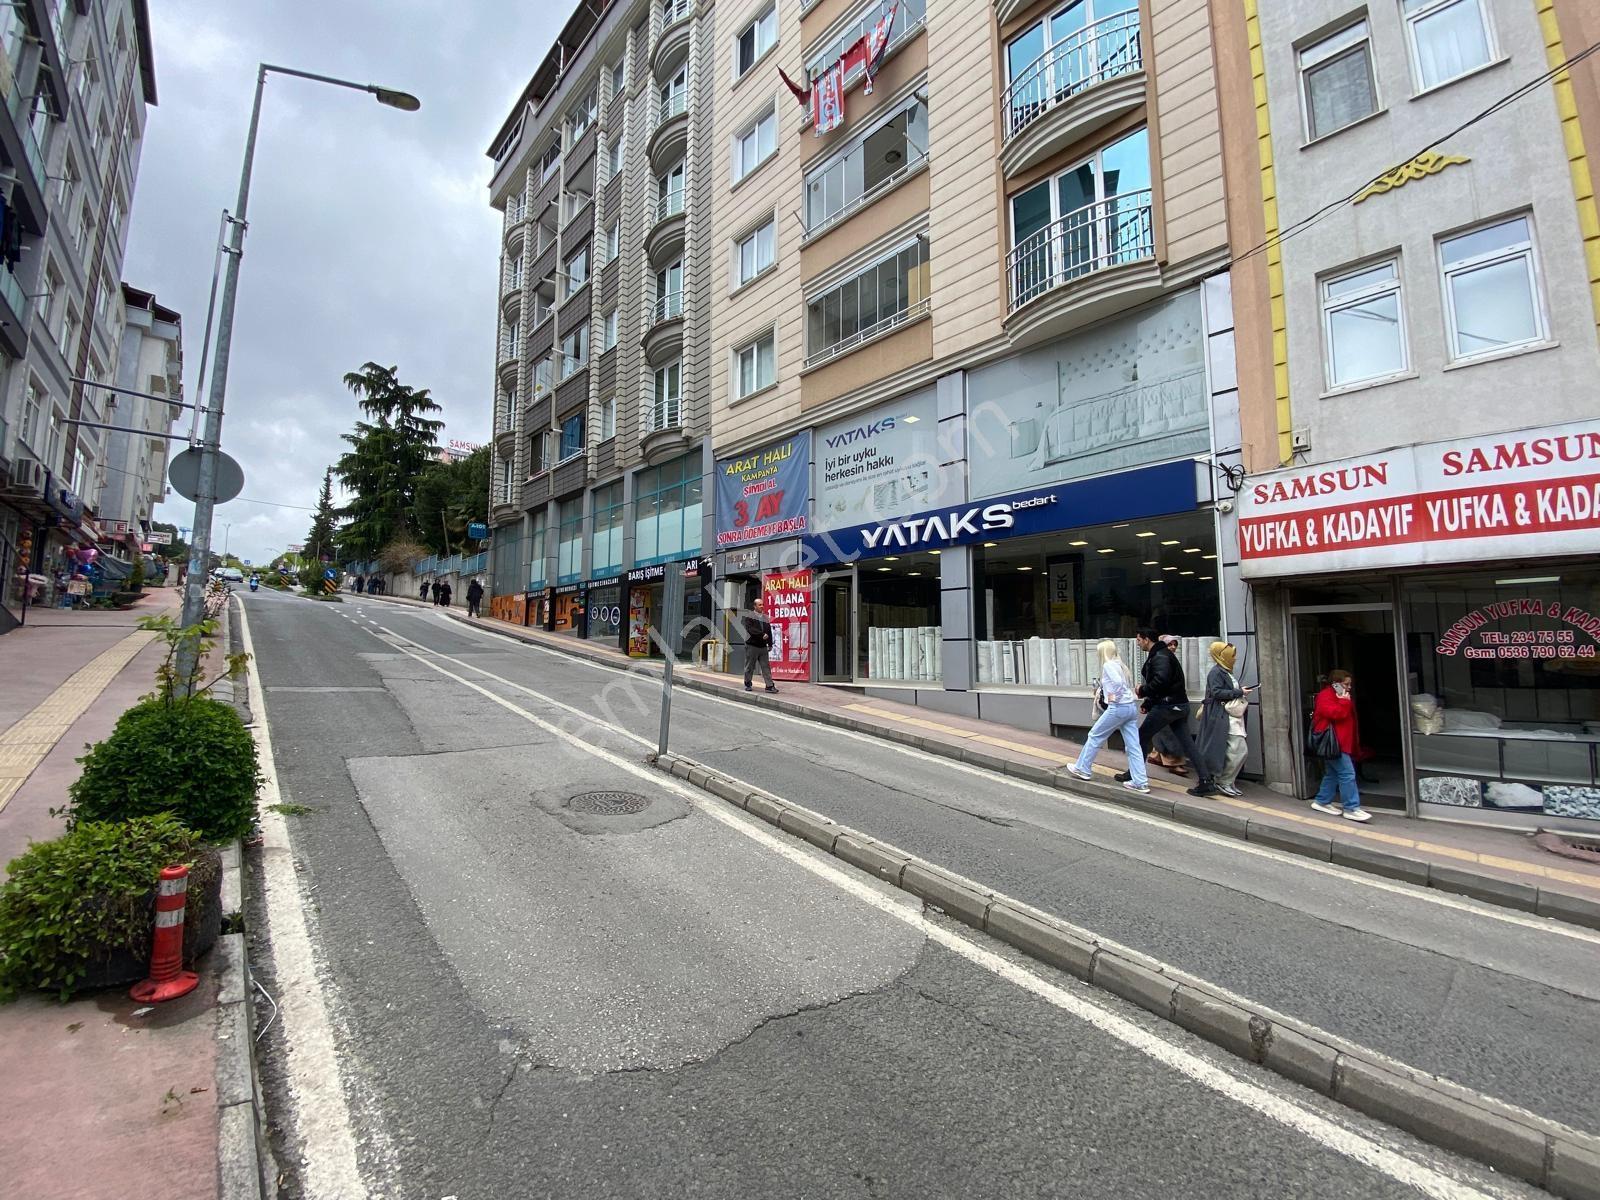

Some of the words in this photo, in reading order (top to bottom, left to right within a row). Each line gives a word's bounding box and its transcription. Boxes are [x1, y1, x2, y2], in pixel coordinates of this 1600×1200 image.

[826, 417, 895, 448] YATAKS
[726, 455, 760, 476] ARAT
[763, 443, 792, 466] HALI
[825, 458, 836, 471] İyi
[838, 454, 850, 466] bir
[853, 447, 877, 462] uyku
[825, 464, 864, 482] herkesin
[866, 455, 894, 471] hakkı
[741, 466, 779, 483] KAMPANYA
[767, 478, 777, 489] AL
[1253, 461, 1389, 505] SAMSUN
[733, 500, 749, 527] 3
[754, 490, 785, 523] AY
[860, 503, 1015, 549] YATAKS
[1012, 494, 1057, 510] bedart
[1426, 495, 1509, 533] YUFKA
[1515, 491, 1533, 526] &
[718, 529, 743, 544] SONRA
[743, 524, 777, 541] ÖDEMEYE
[777, 515, 806, 533] BAŞLA
[1241, 520, 1302, 553] YUFKA
[1305, 517, 1319, 546] &
[1322, 502, 1414, 544] KADAYIF
[765, 579, 785, 592] ARAT
[788, 575, 809, 588] HALI
[774, 592, 805, 605] ALANA
[774, 606, 808, 618] BEDAVA
[1436, 610, 1488, 656] SAMSUN
[1483, 599, 1543, 620] YUFKA
[1547, 601, 1561, 618] &
[1481, 632, 1509, 644] TEL:
[1511, 631, 1535, 643] 234
[1537, 631, 1555, 643] 75
[1556, 630, 1574, 643] 55
[1464, 647, 1496, 659] Gsm:
[1498, 646, 1529, 658] 0536
[1531, 645, 1556, 658] 790
[1557, 645, 1576, 658] 62
[1577, 644, 1596, 658] 44
